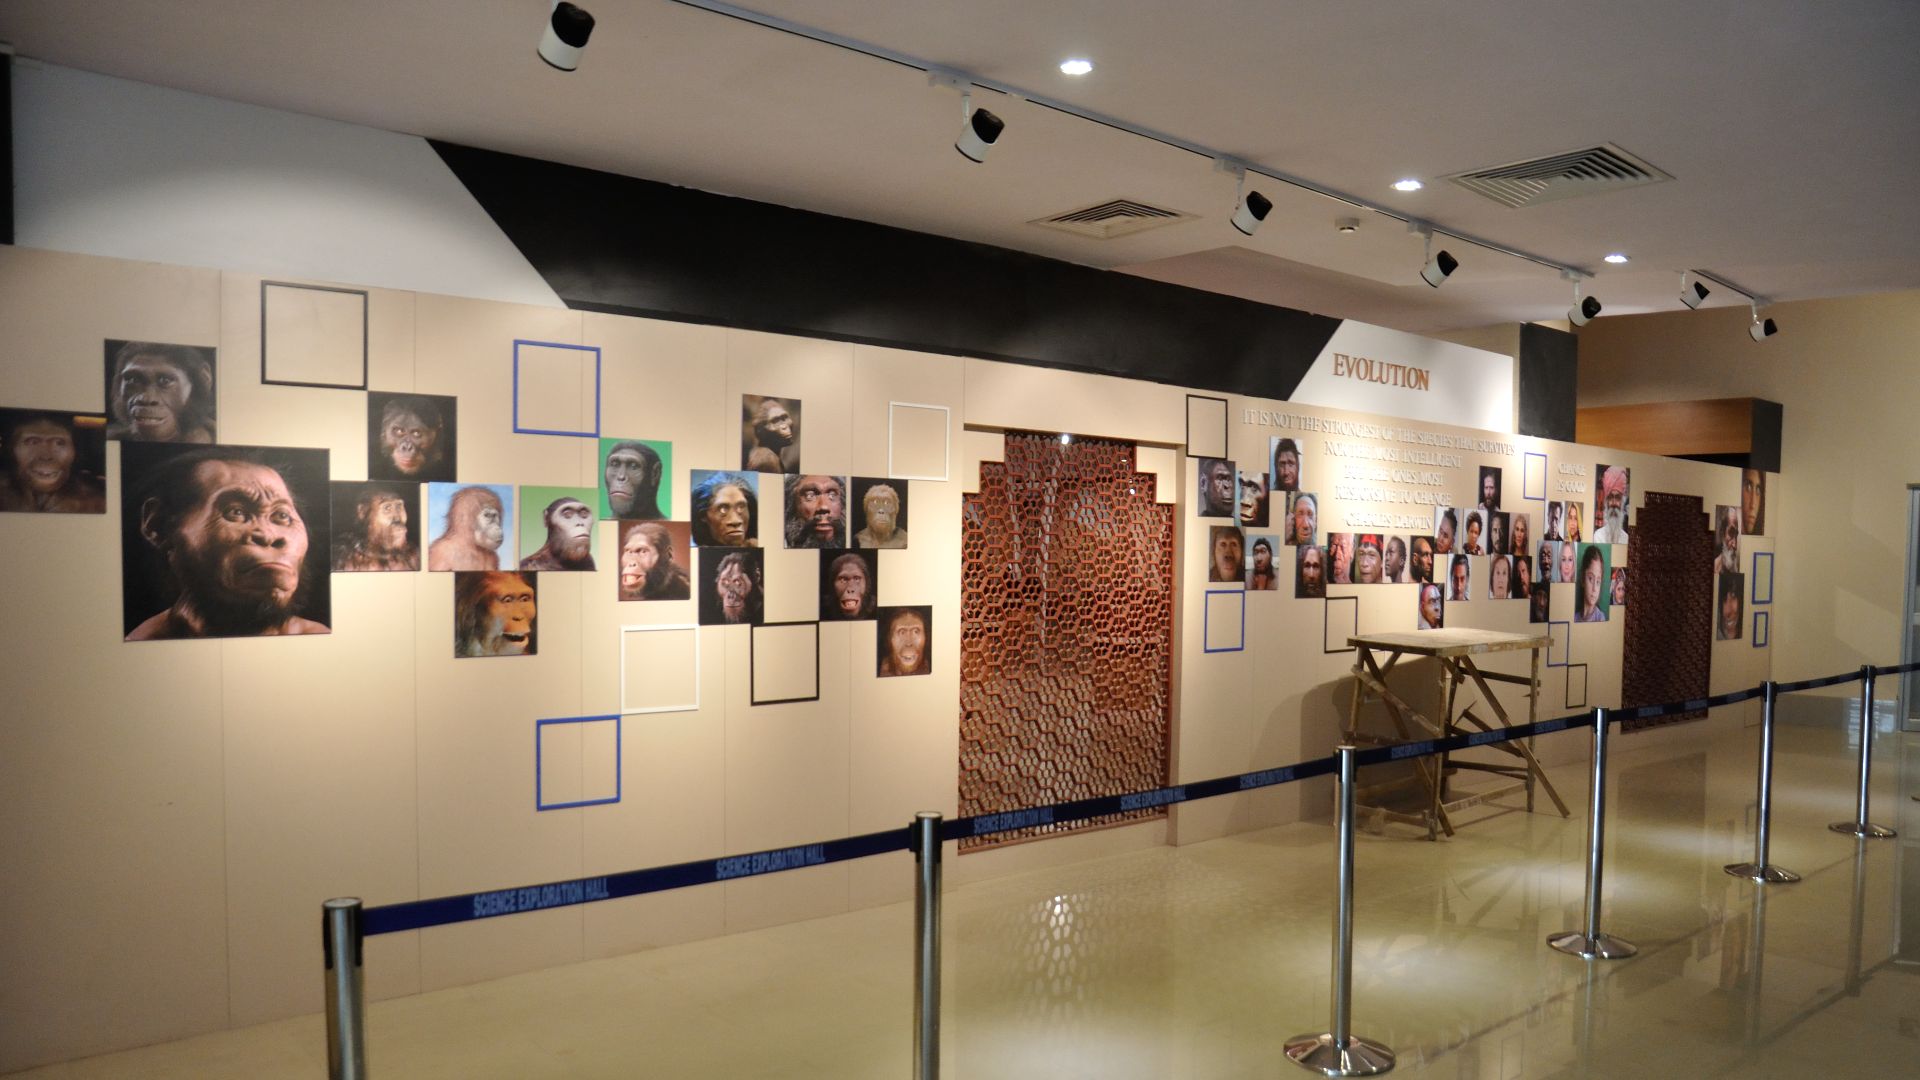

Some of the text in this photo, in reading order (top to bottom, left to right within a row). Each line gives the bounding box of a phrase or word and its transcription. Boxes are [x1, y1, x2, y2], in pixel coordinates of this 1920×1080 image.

[1332, 352, 1430, 391] EVOLUTION
[1243, 409, 1257, 425] IT
[1258, 411, 1269, 426] IS
[1270, 412, 1296, 429] NOT
[1298, 415, 1320, 432] THE
[1321, 418, 1380, 440] STRONGEST
[1397, 428, 1416, 444] THE
[1418, 431, 1453, 449] SPECIES
[1478, 439, 1516, 456] SURVIVES
[1402, 450, 1462, 469] INTELLIGENT
[1413, 490, 1452, 507] CHANGE
[716, 843, 826, 880] SCIENCE EXPLORATION HALL
[473, 877, 609, 917] SCIENCE EXPLORATION HALL
